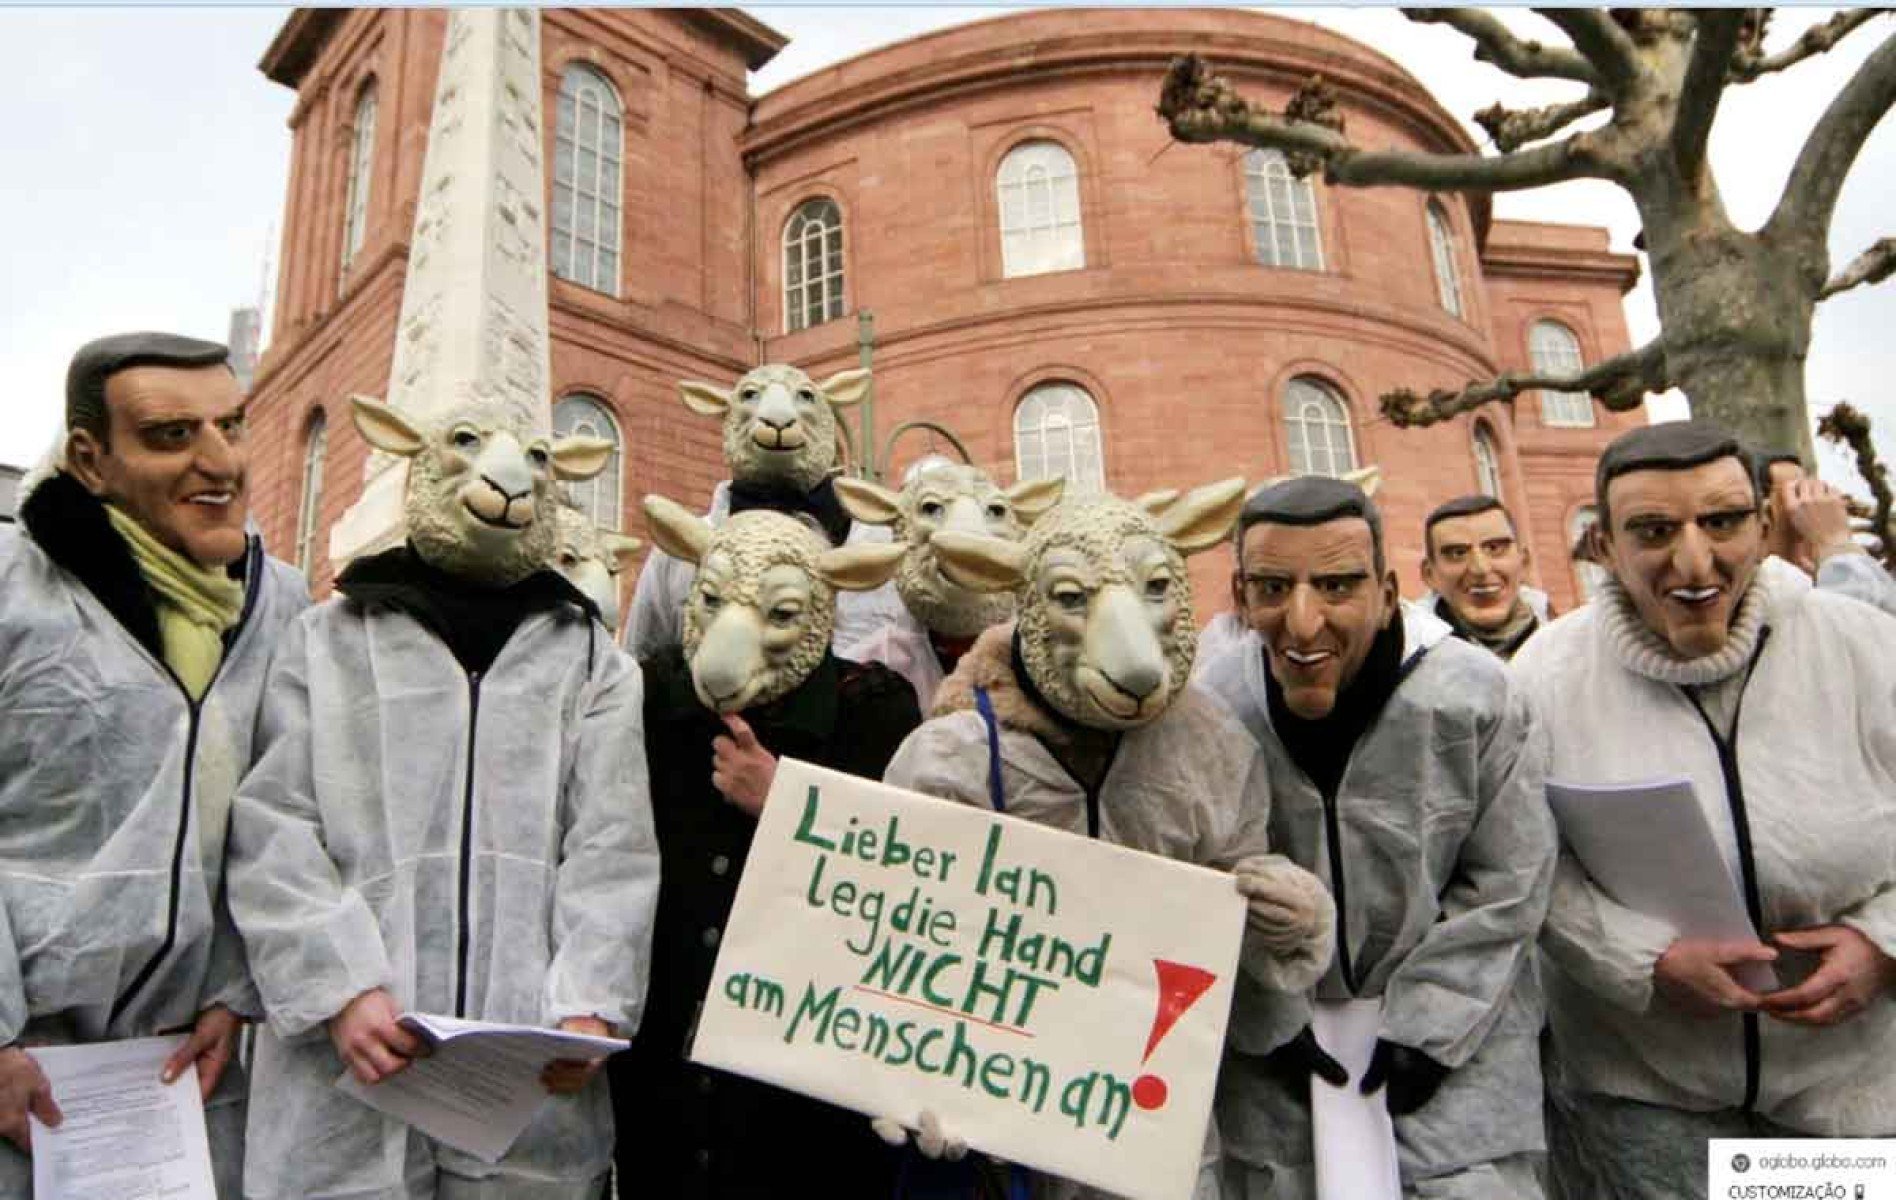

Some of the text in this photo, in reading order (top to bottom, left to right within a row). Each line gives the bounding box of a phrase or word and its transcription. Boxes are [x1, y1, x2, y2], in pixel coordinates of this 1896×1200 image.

[793, 785, 956, 881] Lieber
[862, 937, 1059, 1028] NICHT
[979, 907, 1112, 988] Hand
[723, 971, 785, 1017] am
[784, 981, 1050, 1113] Menschen
